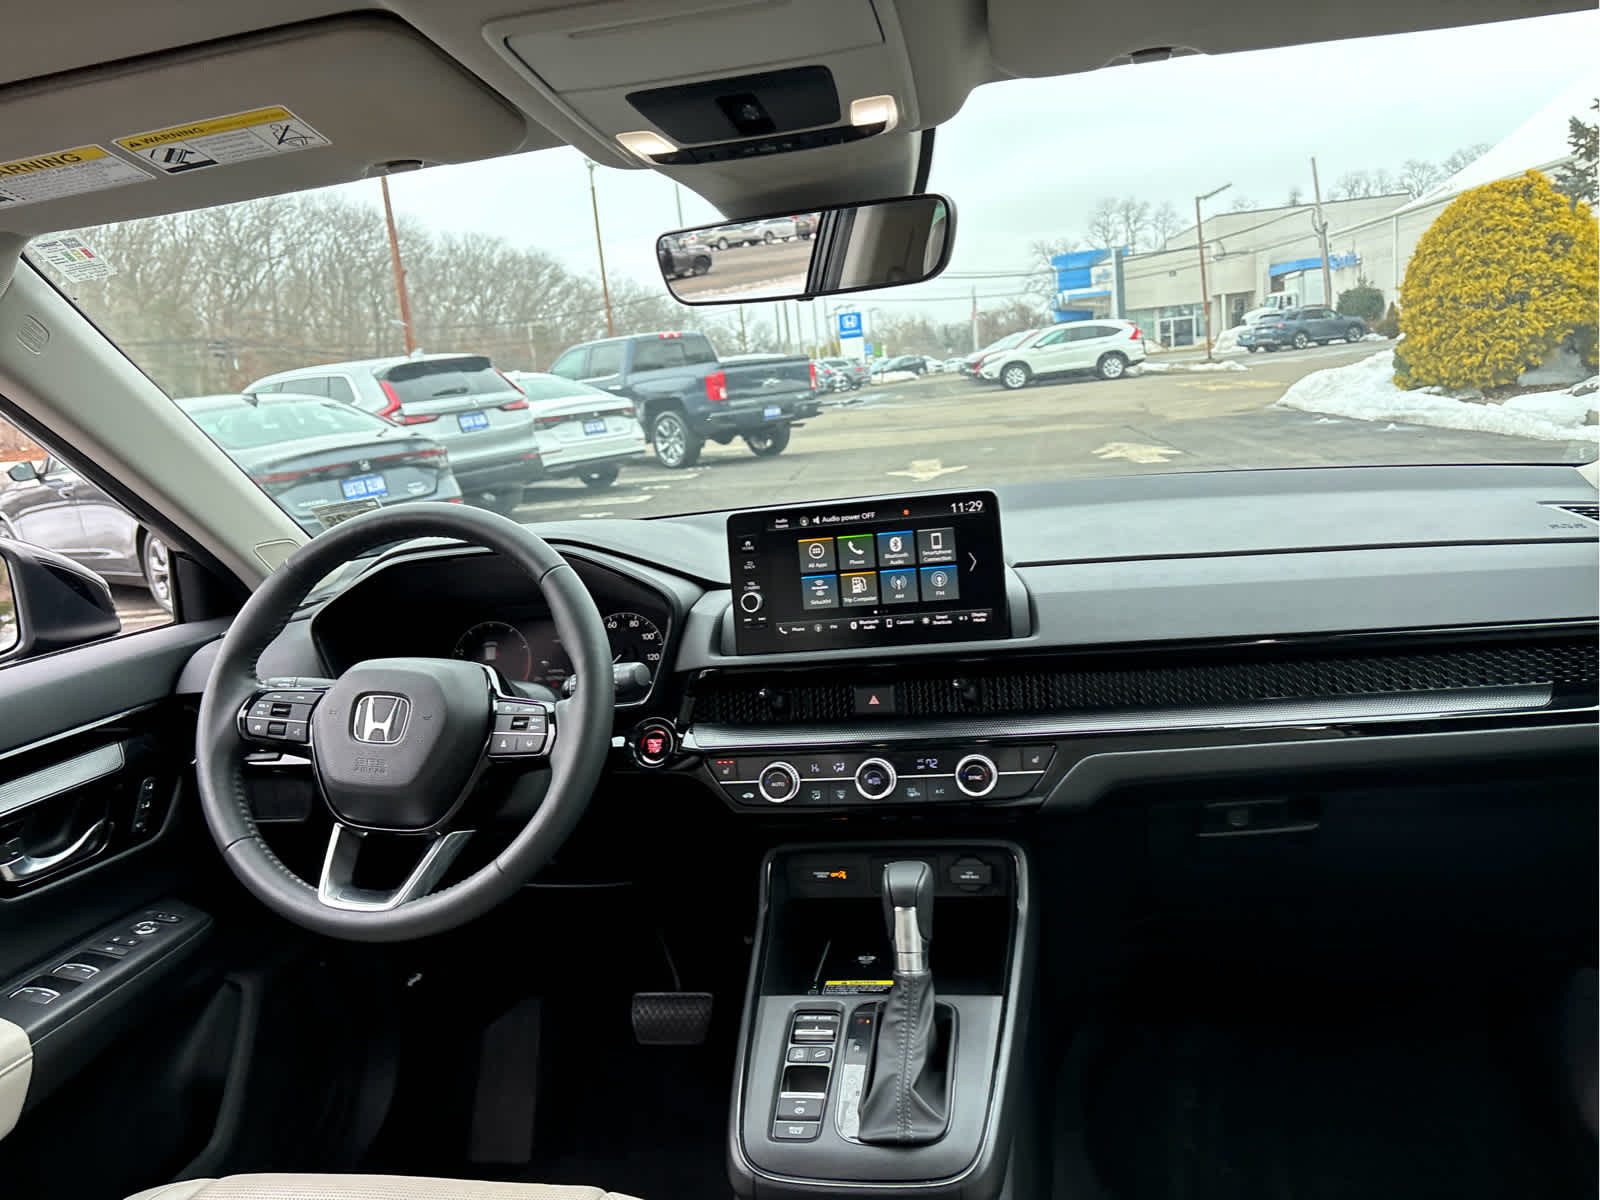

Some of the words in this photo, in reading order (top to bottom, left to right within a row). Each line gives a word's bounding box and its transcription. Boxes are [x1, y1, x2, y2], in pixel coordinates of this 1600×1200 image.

[143, 128, 205, 145] WARNING
[951, 500, 984, 512] 11:29
[841, 514, 860, 522] power
[861, 511, 876, 519] OFF
[629, 620, 639, 628] 80
[641, 632, 655, 640] 100
